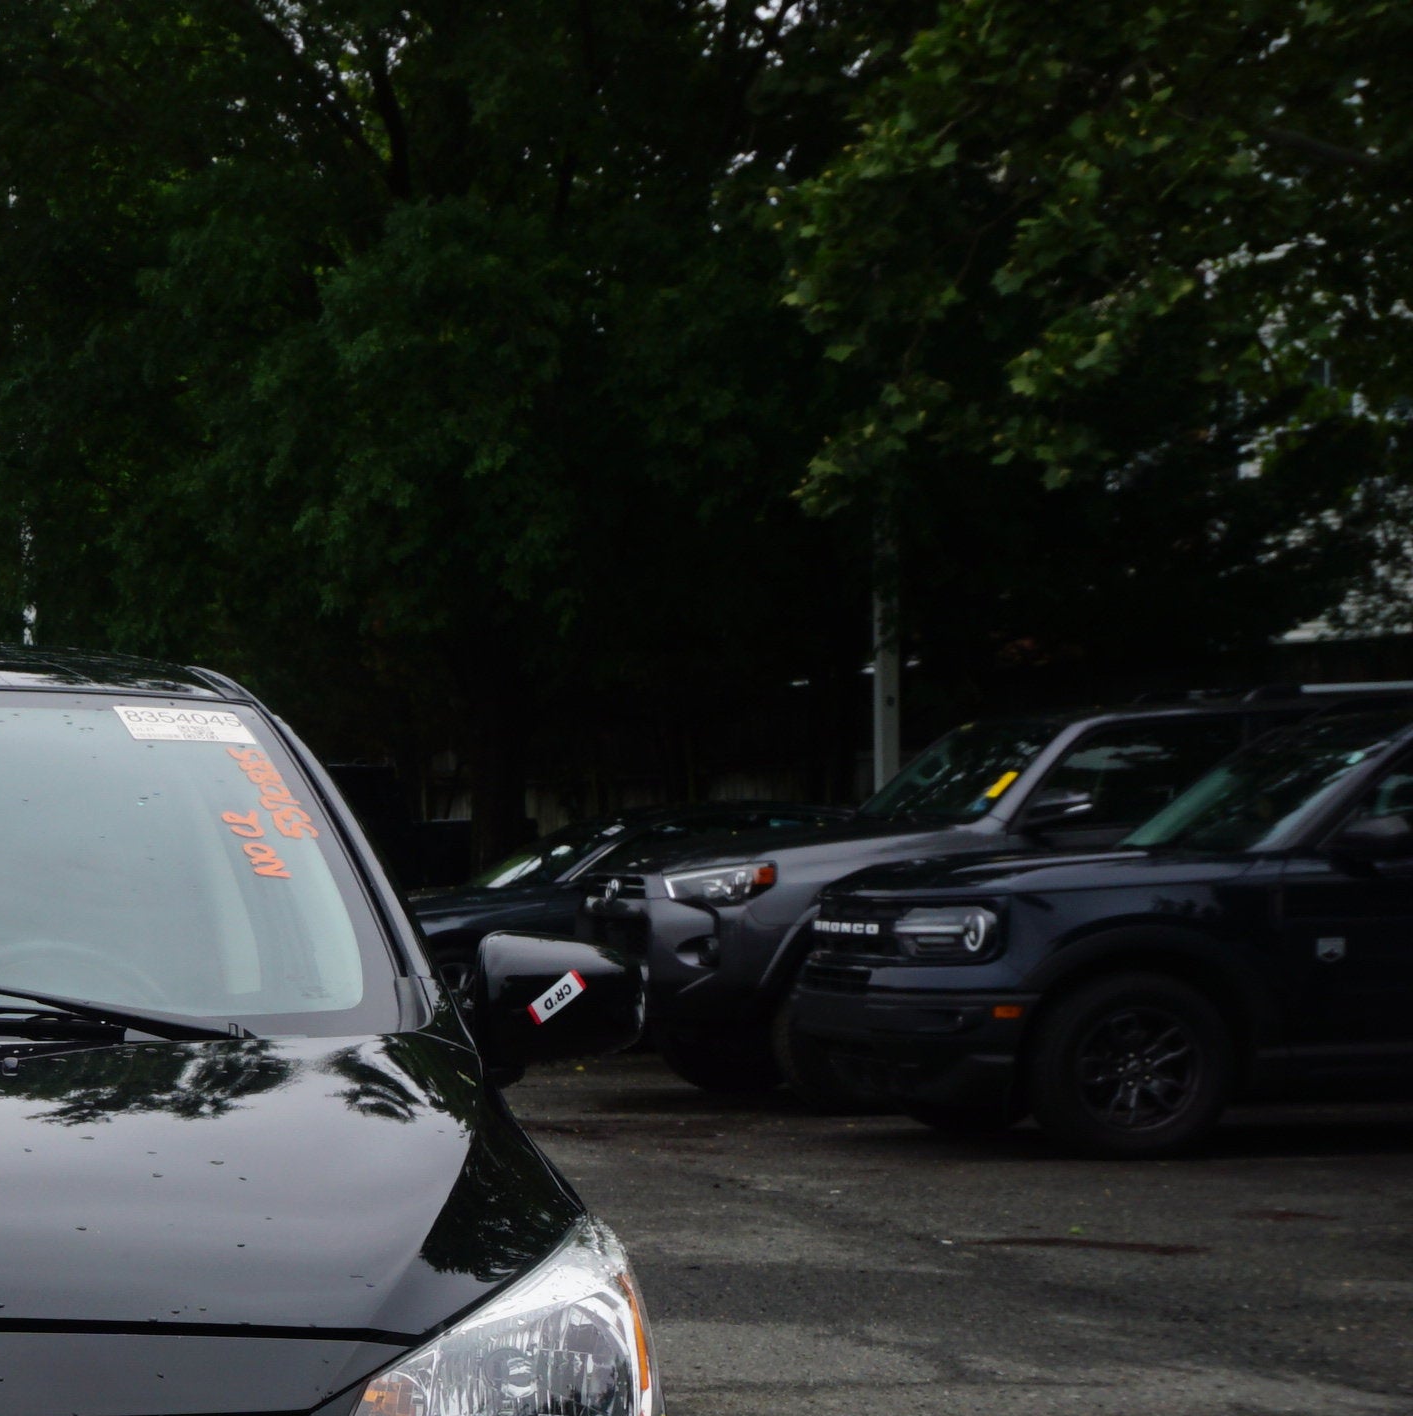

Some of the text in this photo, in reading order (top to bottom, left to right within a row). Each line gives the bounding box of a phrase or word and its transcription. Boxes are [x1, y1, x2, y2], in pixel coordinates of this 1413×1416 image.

[124, 710, 242, 728] 8354045
[243, 842, 292, 879] NO
[813, 920, 880, 935] BRONCO
[544, 983, 572, 1011] CR'D
